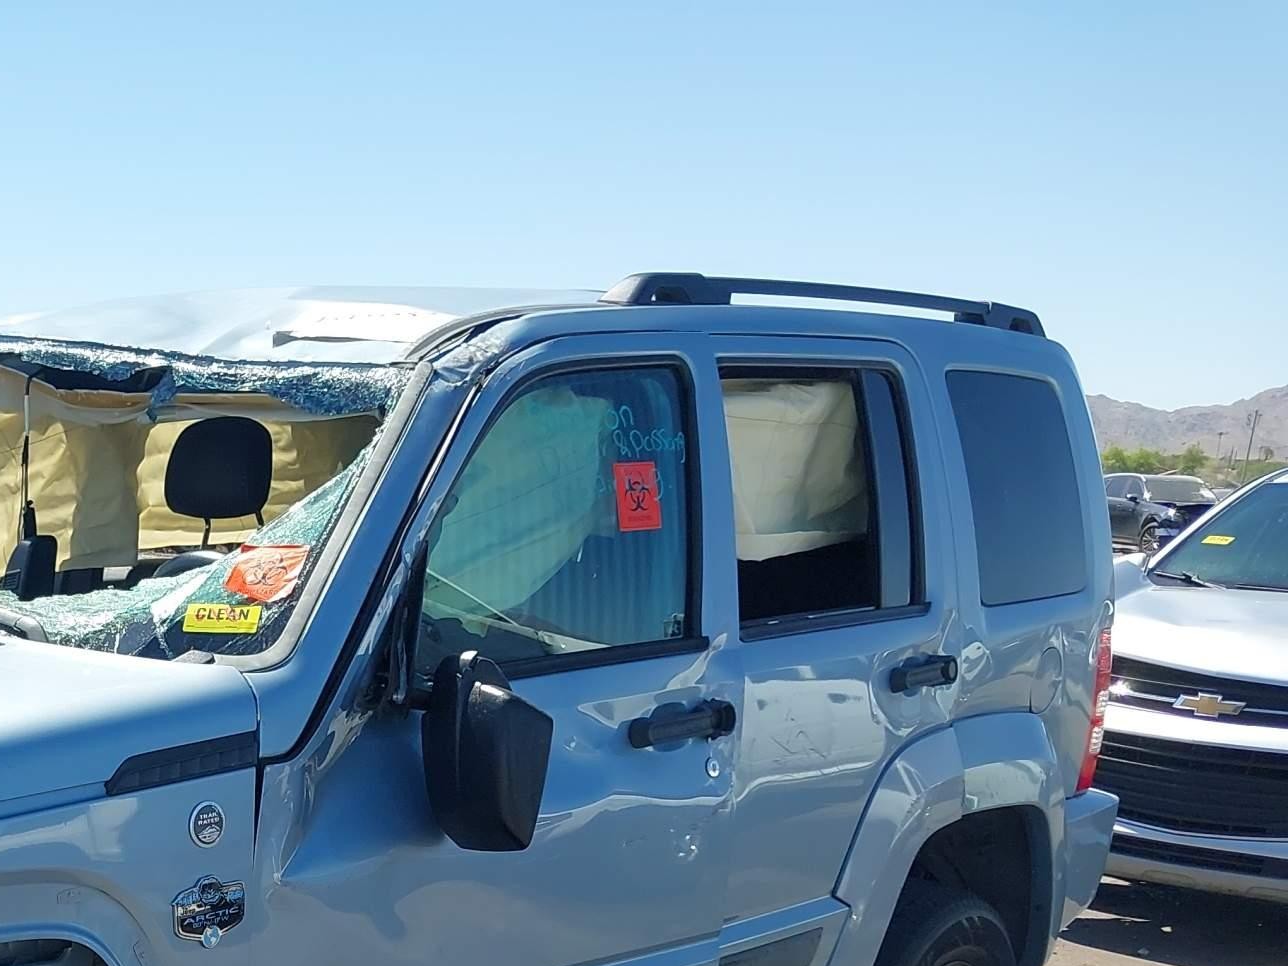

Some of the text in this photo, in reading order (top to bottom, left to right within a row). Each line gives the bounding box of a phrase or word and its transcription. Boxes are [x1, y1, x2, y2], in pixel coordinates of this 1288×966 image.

[195, 607, 250, 621] CLEAN
[197, 816, 220, 826] RATED
[199, 811, 218, 820] TRAIL
[183, 905, 240, 925] ARCTIC
